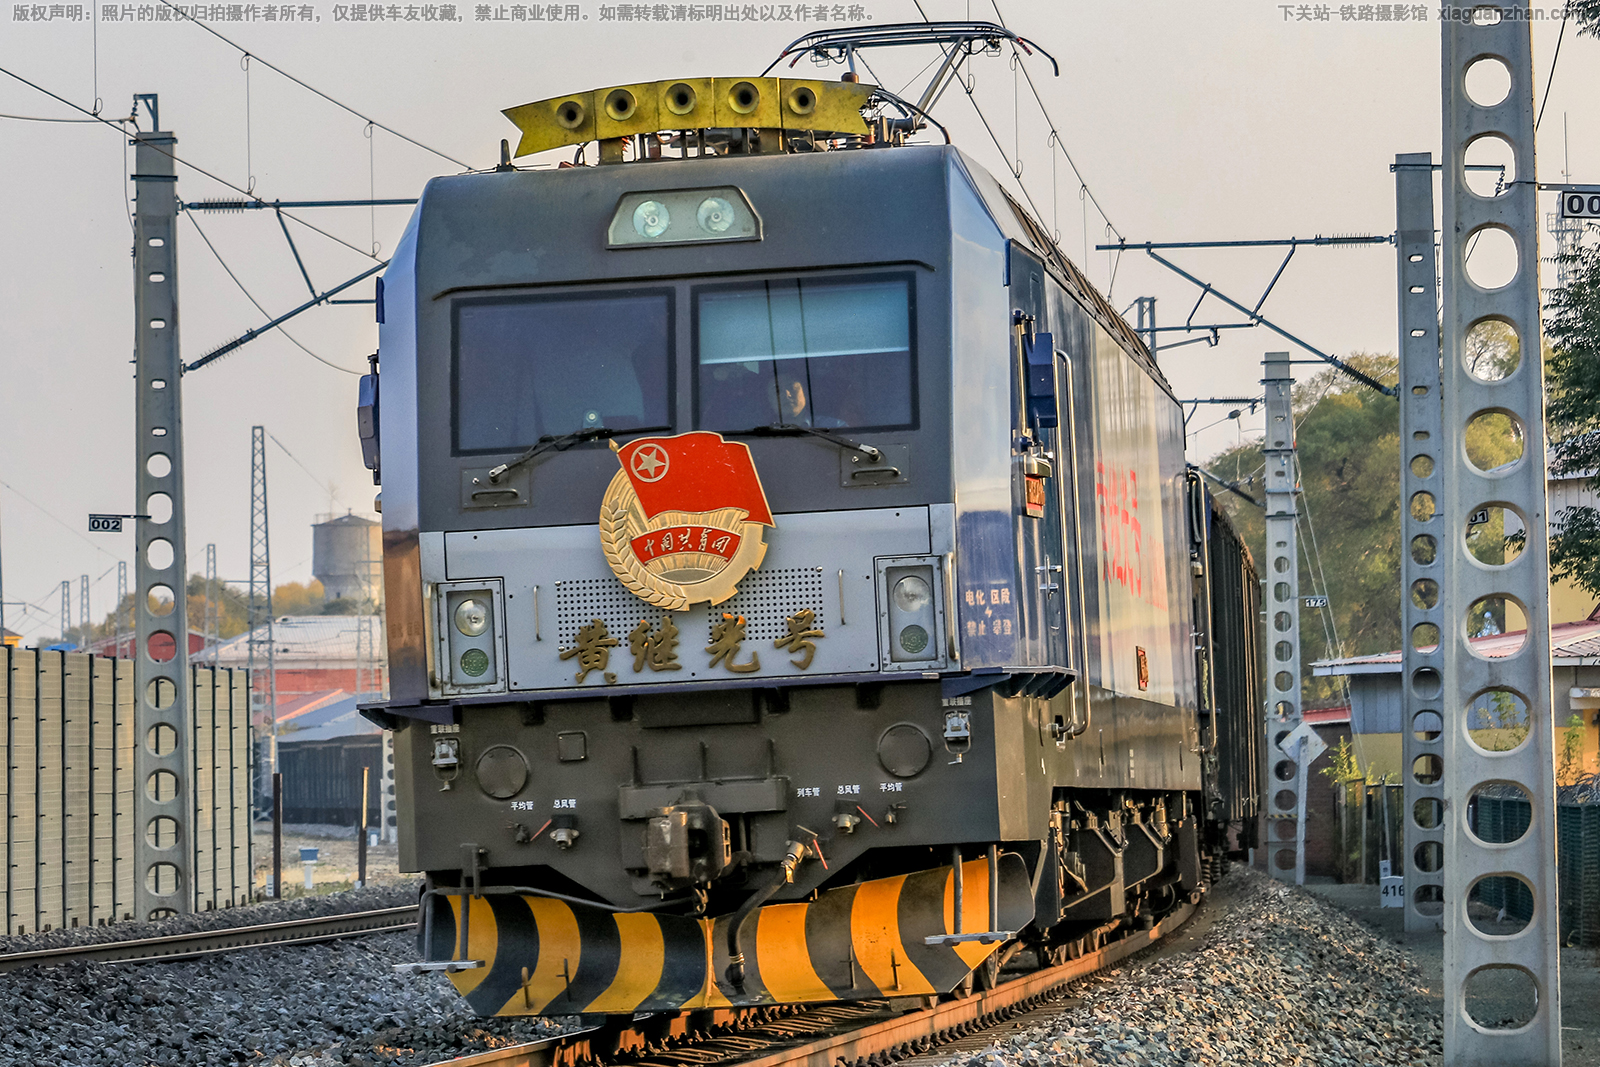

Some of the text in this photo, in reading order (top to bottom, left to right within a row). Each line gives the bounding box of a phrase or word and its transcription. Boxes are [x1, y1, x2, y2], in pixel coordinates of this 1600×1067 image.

[91, 519, 120, 530] 002
[644, 528, 731, 557] 中国共青团
[559, 609, 825, 684] 黄继光号
[797, 787, 820, 798] 列车管
[837, 784, 860, 795] 总风管
[880, 782, 903, 793] 平均管
[511, 801, 534, 811] 平均管
[553, 798, 577, 809] 总风管
